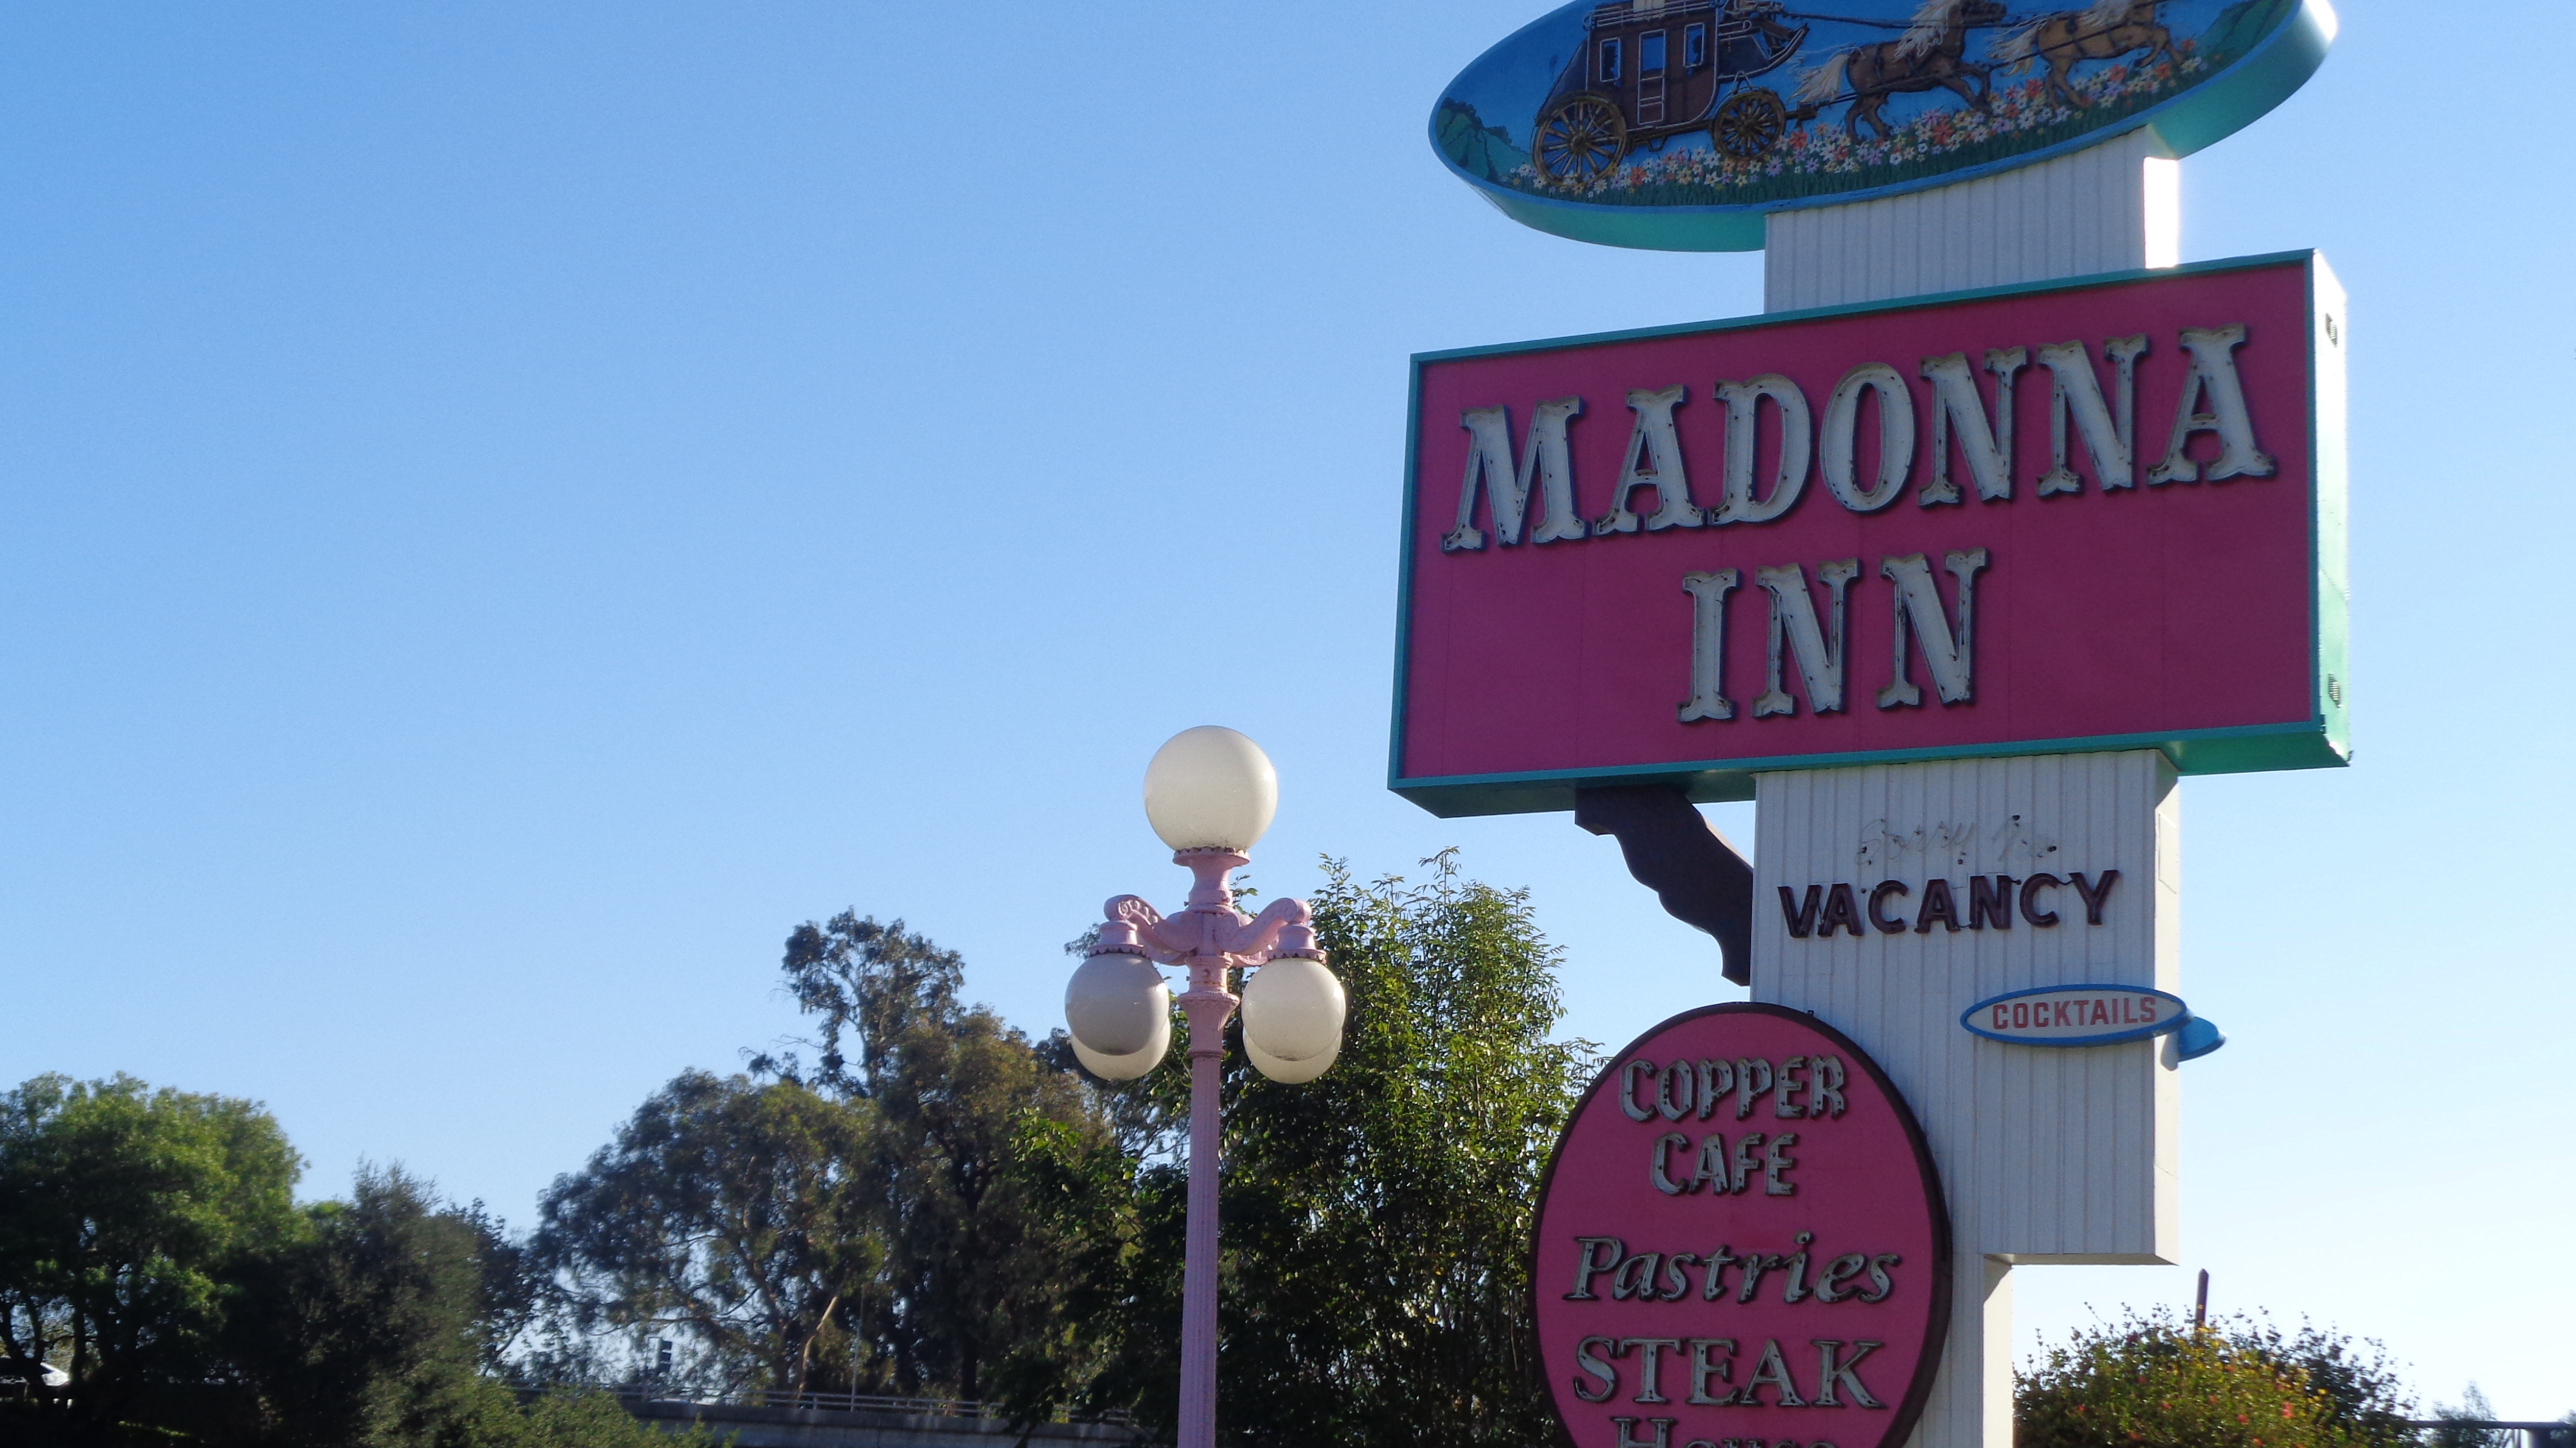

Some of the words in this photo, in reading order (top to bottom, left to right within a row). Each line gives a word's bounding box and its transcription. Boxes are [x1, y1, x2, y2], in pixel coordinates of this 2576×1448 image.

[1442, 324, 2276, 552] MADONNA
[1678, 547, 1989, 723] INN
[1778, 870, 2122, 938] VACANCY
[1993, 997, 2156, 1030] COCKTAILS
[1620, 1054, 1847, 1122] COPPER
[1650, 1132, 1797, 1196] CAFE
[1564, 1230, 1901, 1304] Pastries
[1572, 1335, 1888, 1410] STEAK
